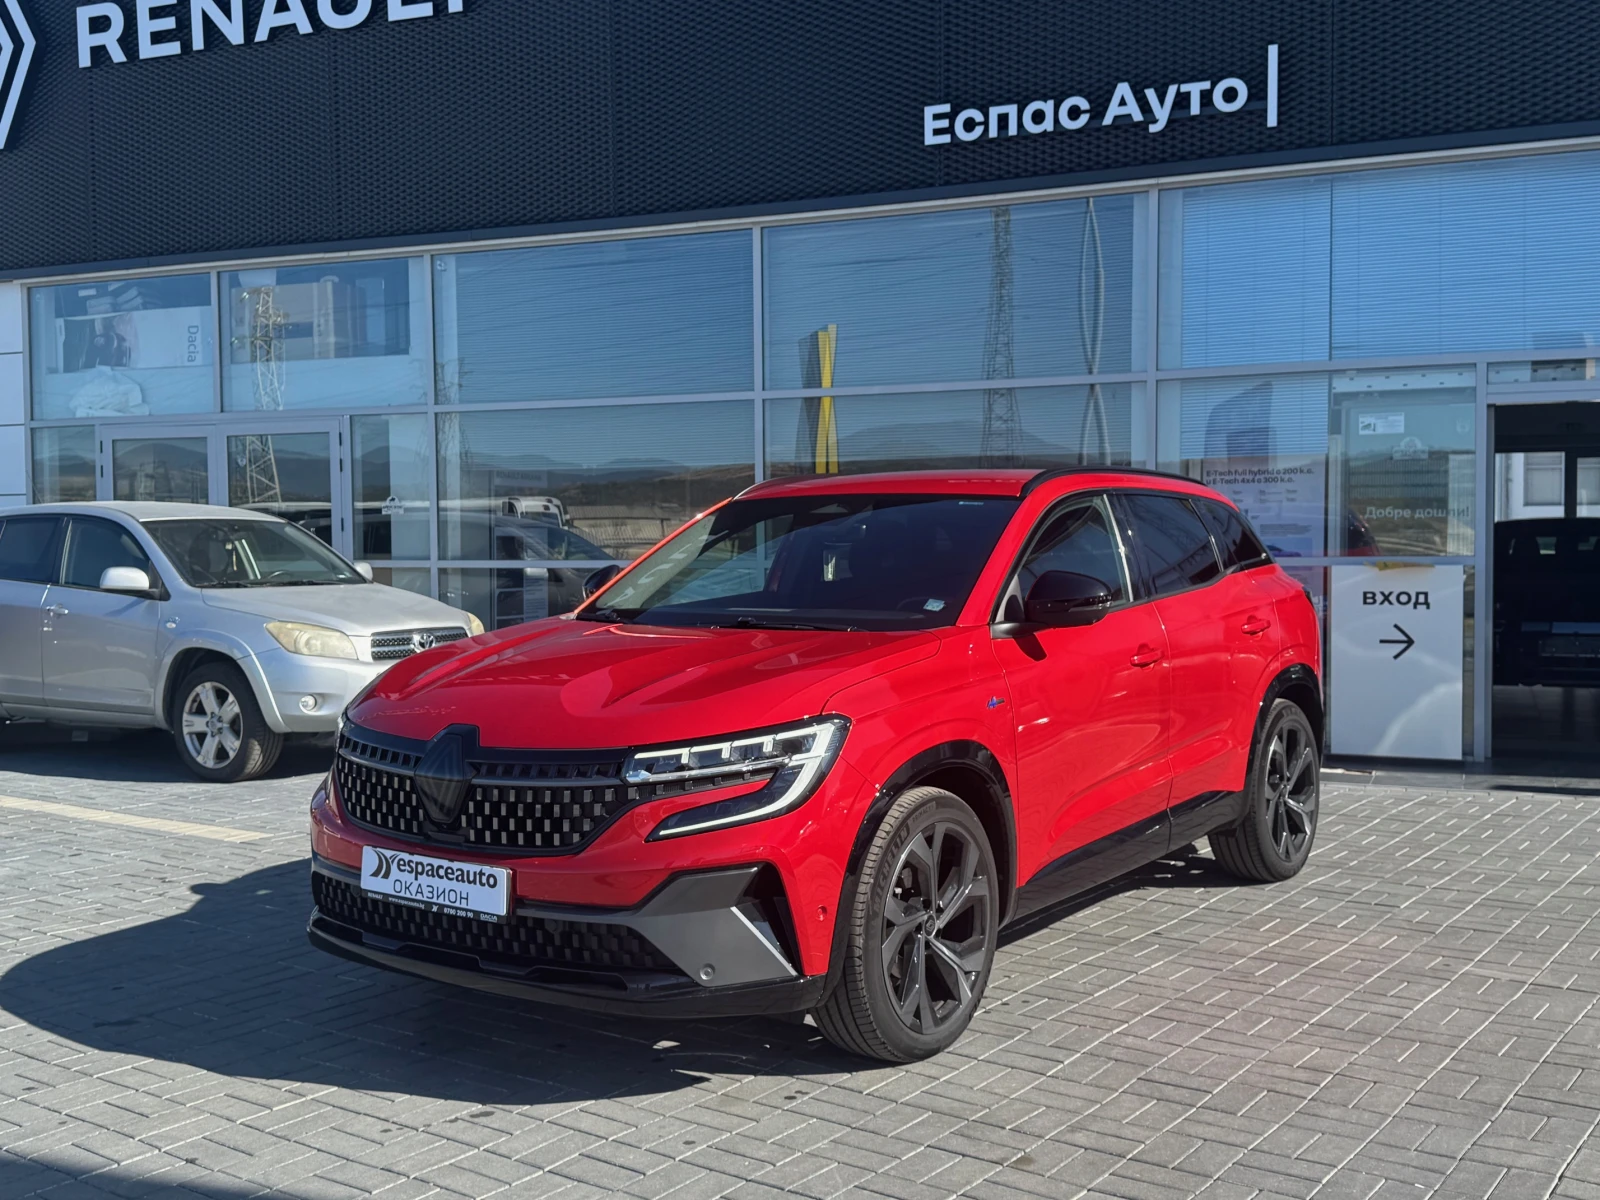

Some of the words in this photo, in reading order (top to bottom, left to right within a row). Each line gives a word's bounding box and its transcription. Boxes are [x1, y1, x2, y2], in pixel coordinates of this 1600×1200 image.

[76, 0, 465, 68] RENAU
[924, 95, 1091, 146] Еспас
[1101, 77, 1249, 133] Ауто
[187, 325, 199, 363] Dacia
[1206, 468, 1233, 477] E-Tech
[1234, 468, 1247, 476] full
[1248, 467, 1275, 478] hybrid
[1364, 506, 1411, 520] Добре
[396, 856, 498, 889] espaceauto
[393, 879, 469, 907] ОКАЗИОН
